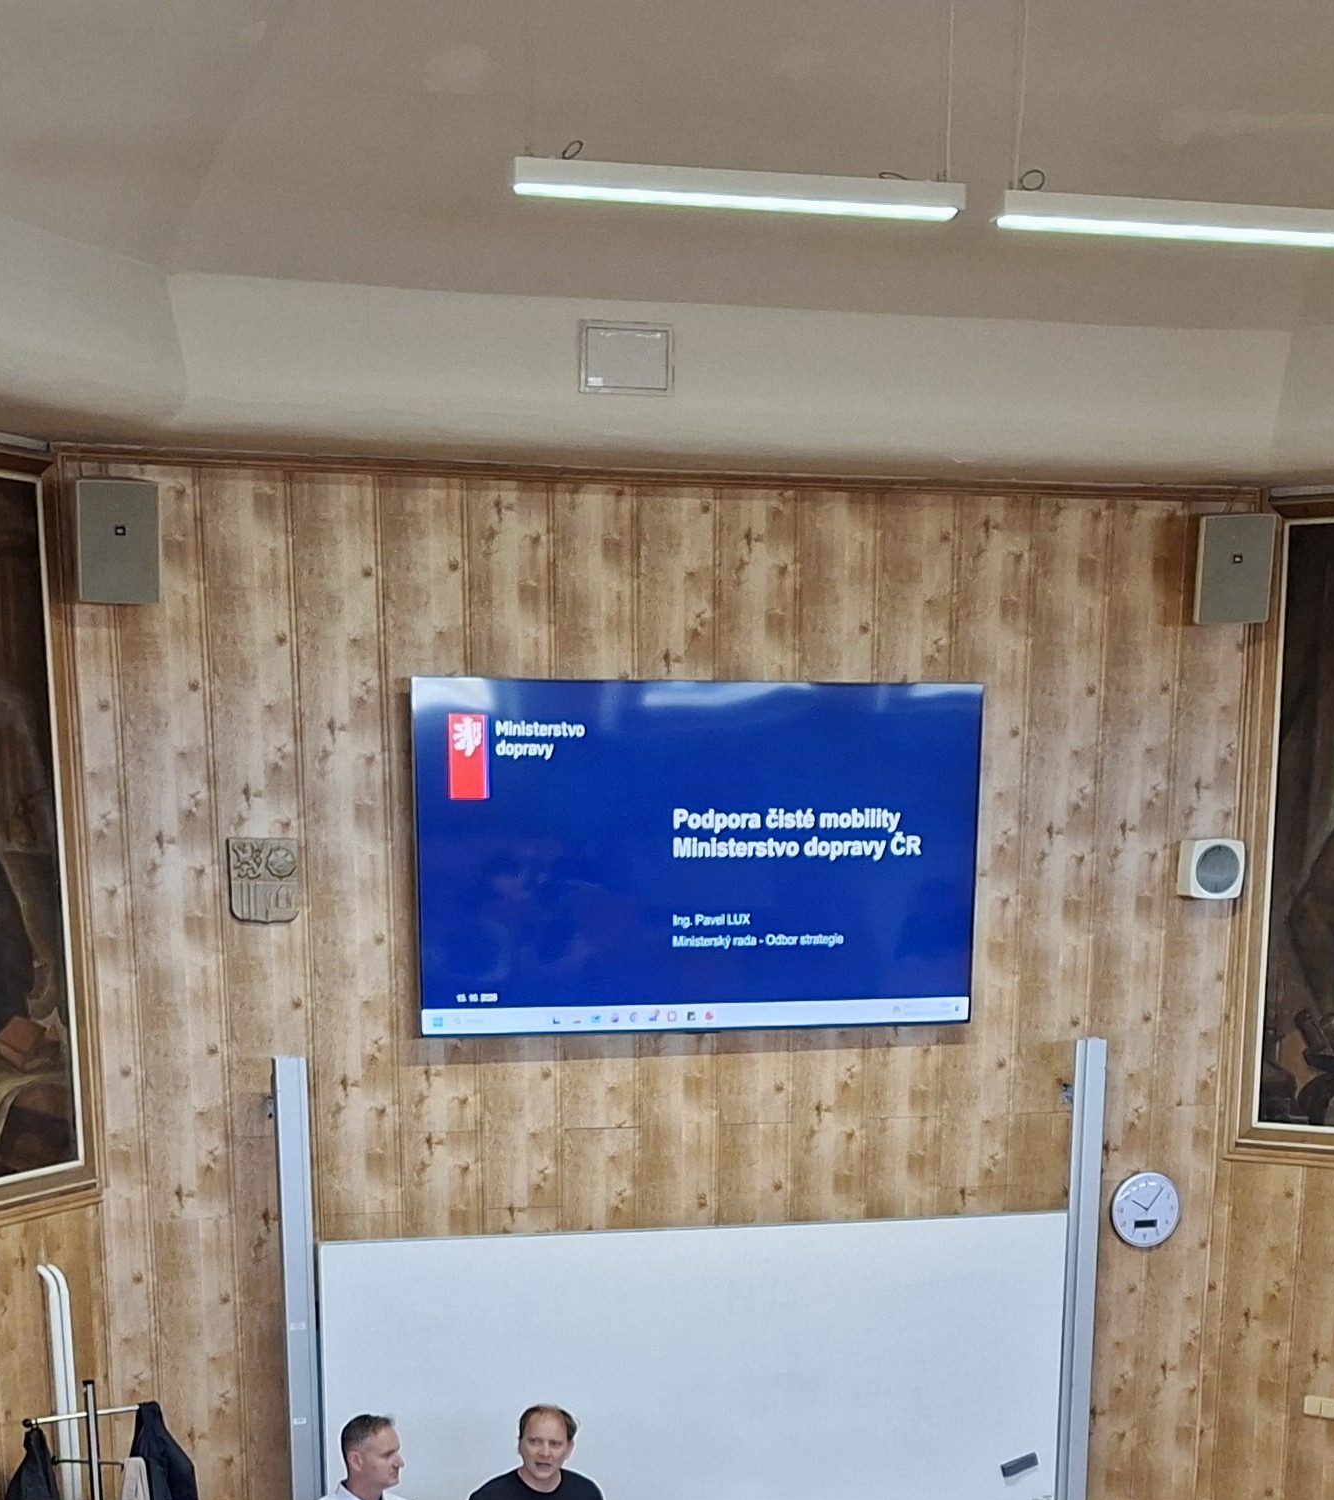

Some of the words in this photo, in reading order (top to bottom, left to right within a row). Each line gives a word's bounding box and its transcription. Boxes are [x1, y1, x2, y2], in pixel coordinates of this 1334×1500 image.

[495, 720, 585, 737] Ministerstvo
[495, 740, 554, 760] dopravy
[673, 808, 761, 834] Podpora
[766, 808, 815, 829] čisté
[819, 807, 901, 832] mobility
[673, 837, 799, 858] Ministerstvo
[803, 836, 886, 861] dopravy
[890, 832, 922, 856] ČR
[672, 914, 693, 928] Ing.
[695, 913, 725, 926] Pavel
[727, 913, 751, 925] LUX
[733, 935, 757, 946] rada
[766, 934, 798, 946] Odbor
[799, 933, 844, 948] strategie
